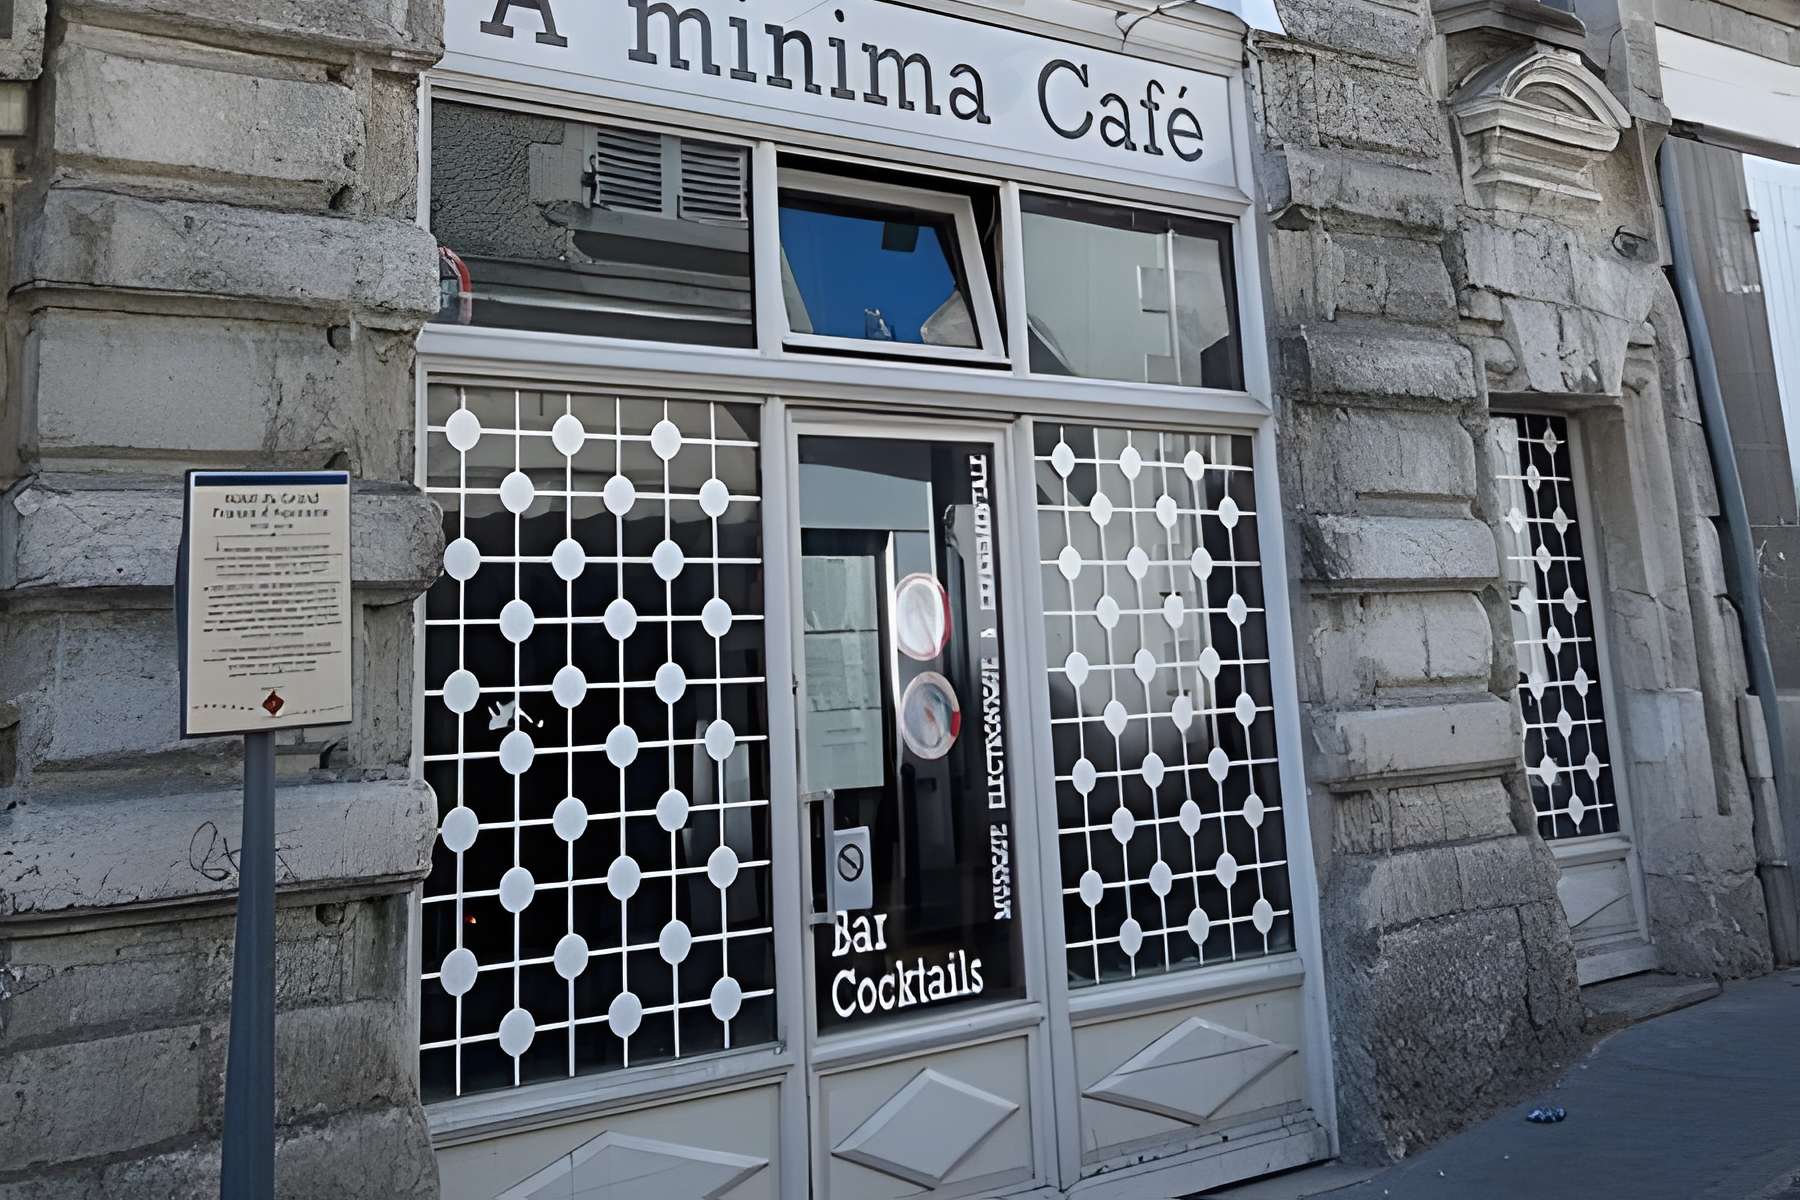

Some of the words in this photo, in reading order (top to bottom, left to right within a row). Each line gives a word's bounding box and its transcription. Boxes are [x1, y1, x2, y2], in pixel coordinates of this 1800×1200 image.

[1038, 58, 1204, 162] Café
[832, 910, 888, 957] Bar
[831, 949, 984, 1018] Cocktails
